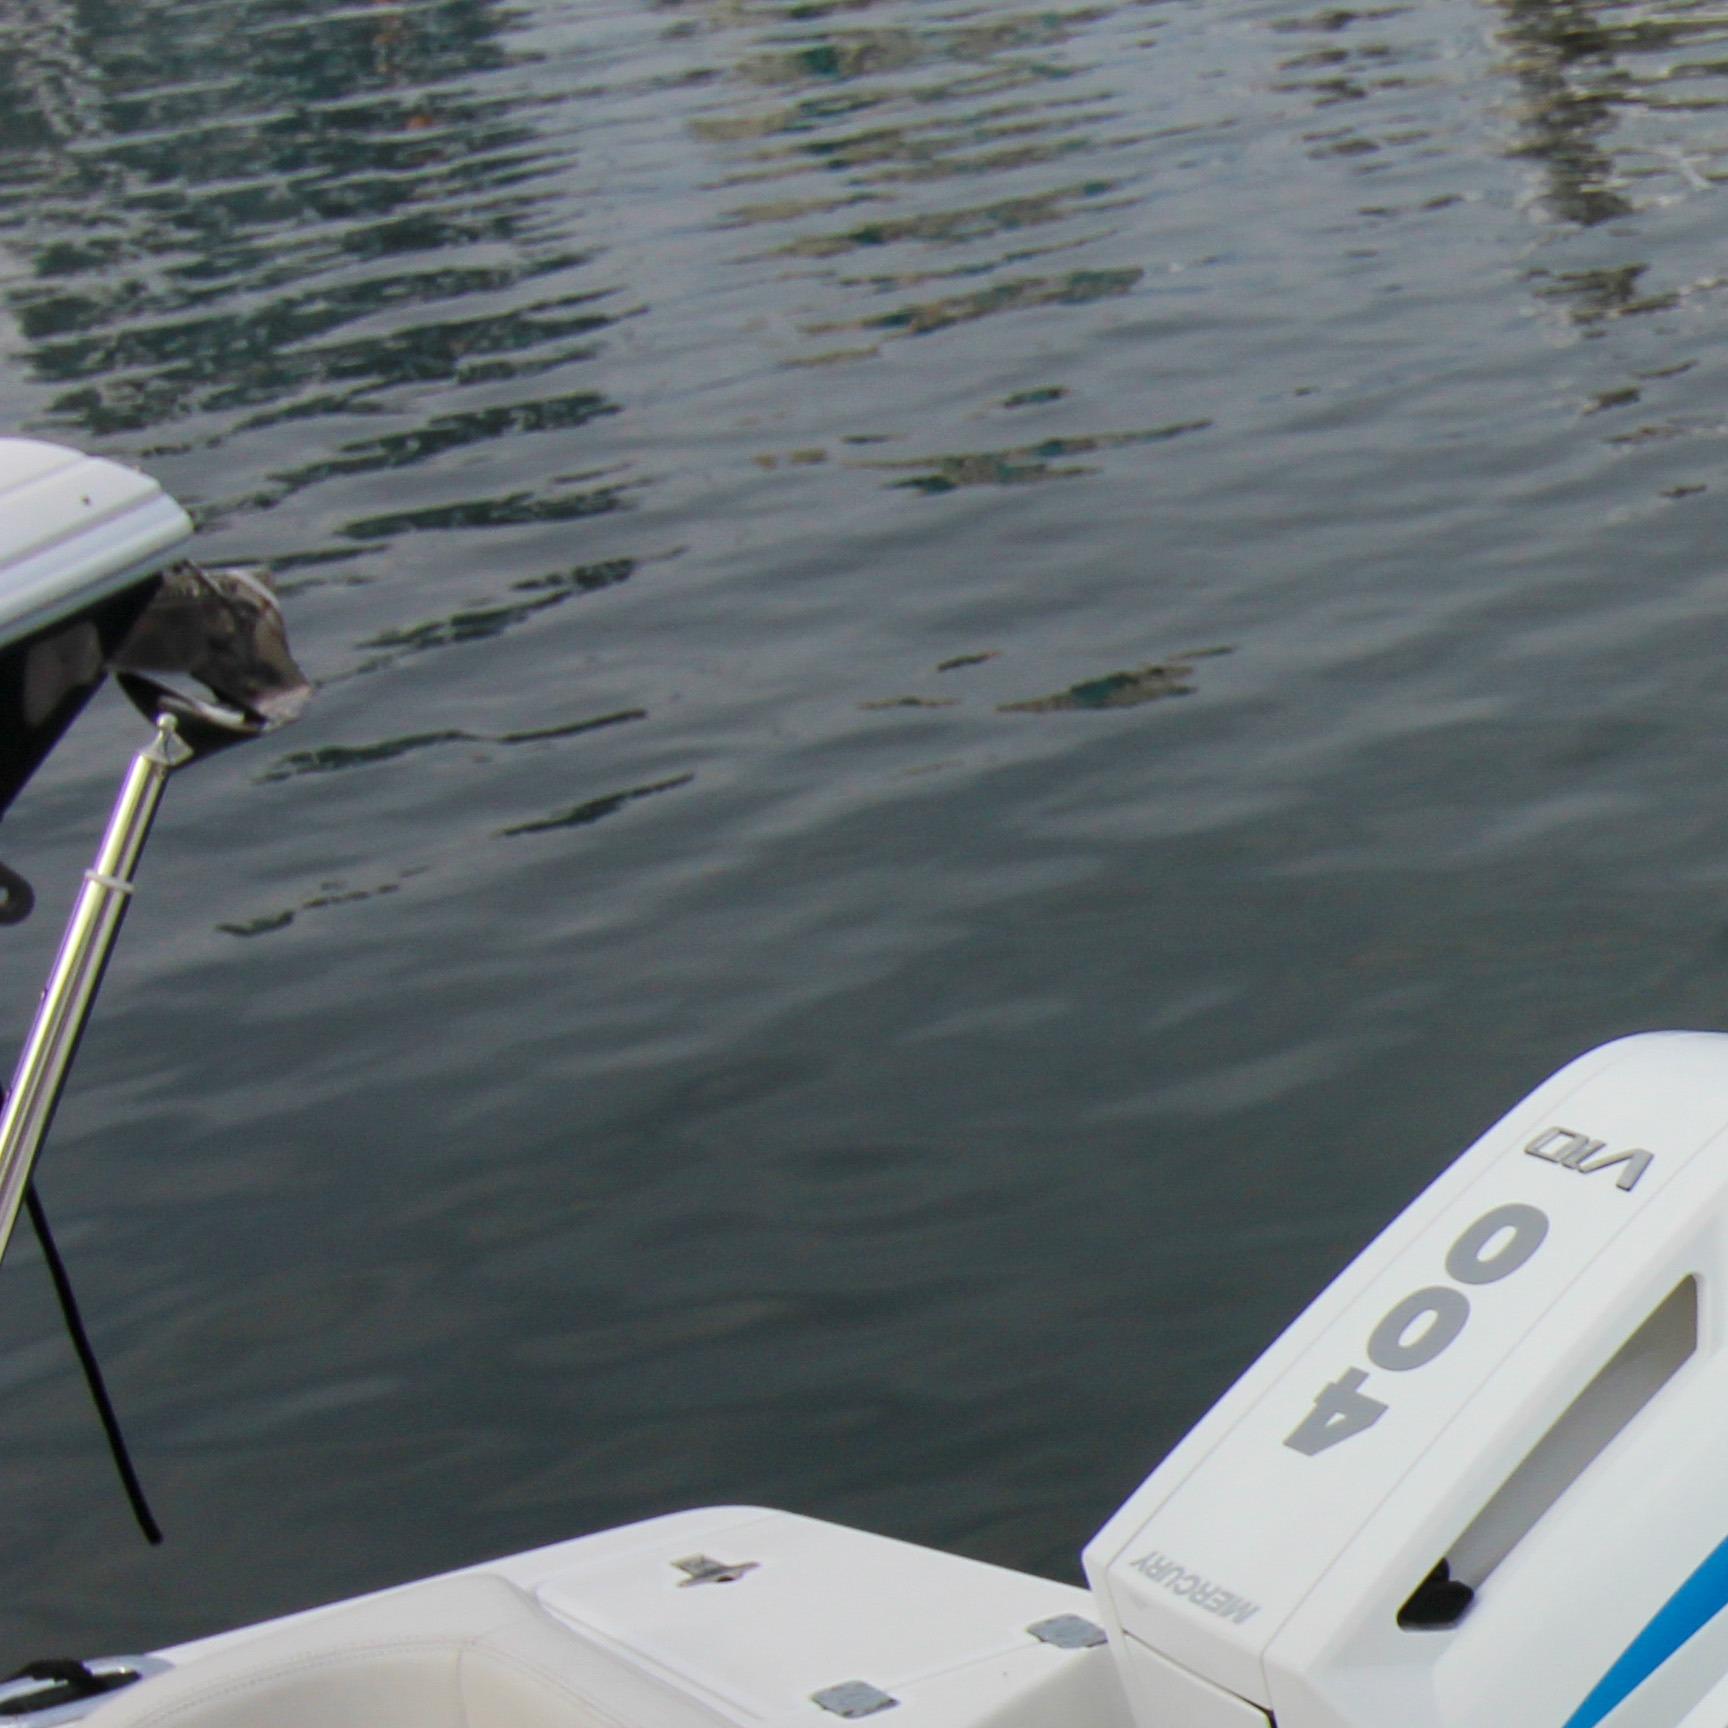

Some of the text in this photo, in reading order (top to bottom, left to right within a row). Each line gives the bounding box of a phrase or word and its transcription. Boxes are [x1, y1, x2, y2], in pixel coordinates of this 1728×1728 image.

[1524, 1126, 1655, 1191] V10
[1283, 1203, 1549, 1456] 400
[1130, 1550, 1261, 1625] MERCURY
